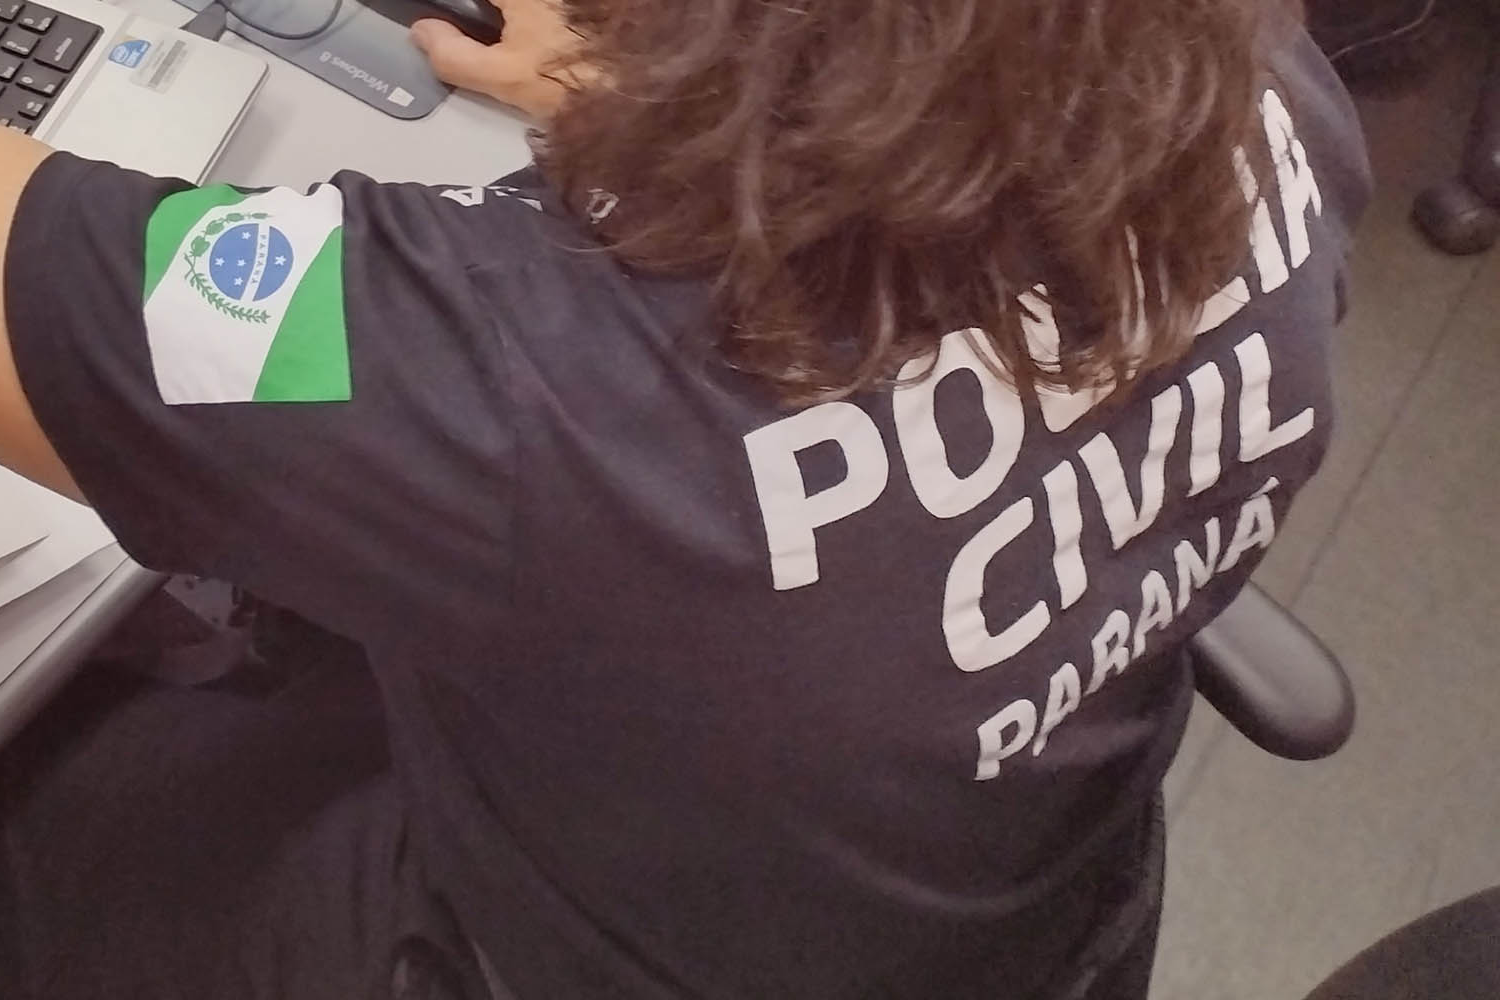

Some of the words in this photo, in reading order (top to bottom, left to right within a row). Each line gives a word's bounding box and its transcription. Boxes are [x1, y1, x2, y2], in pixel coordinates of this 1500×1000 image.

[330, 56, 389, 94] Windows
[743, 88, 1322, 590] POLIA
[942, 332, 1315, 673] CIVIL
[974, 476, 1280, 781] PARANÁ
